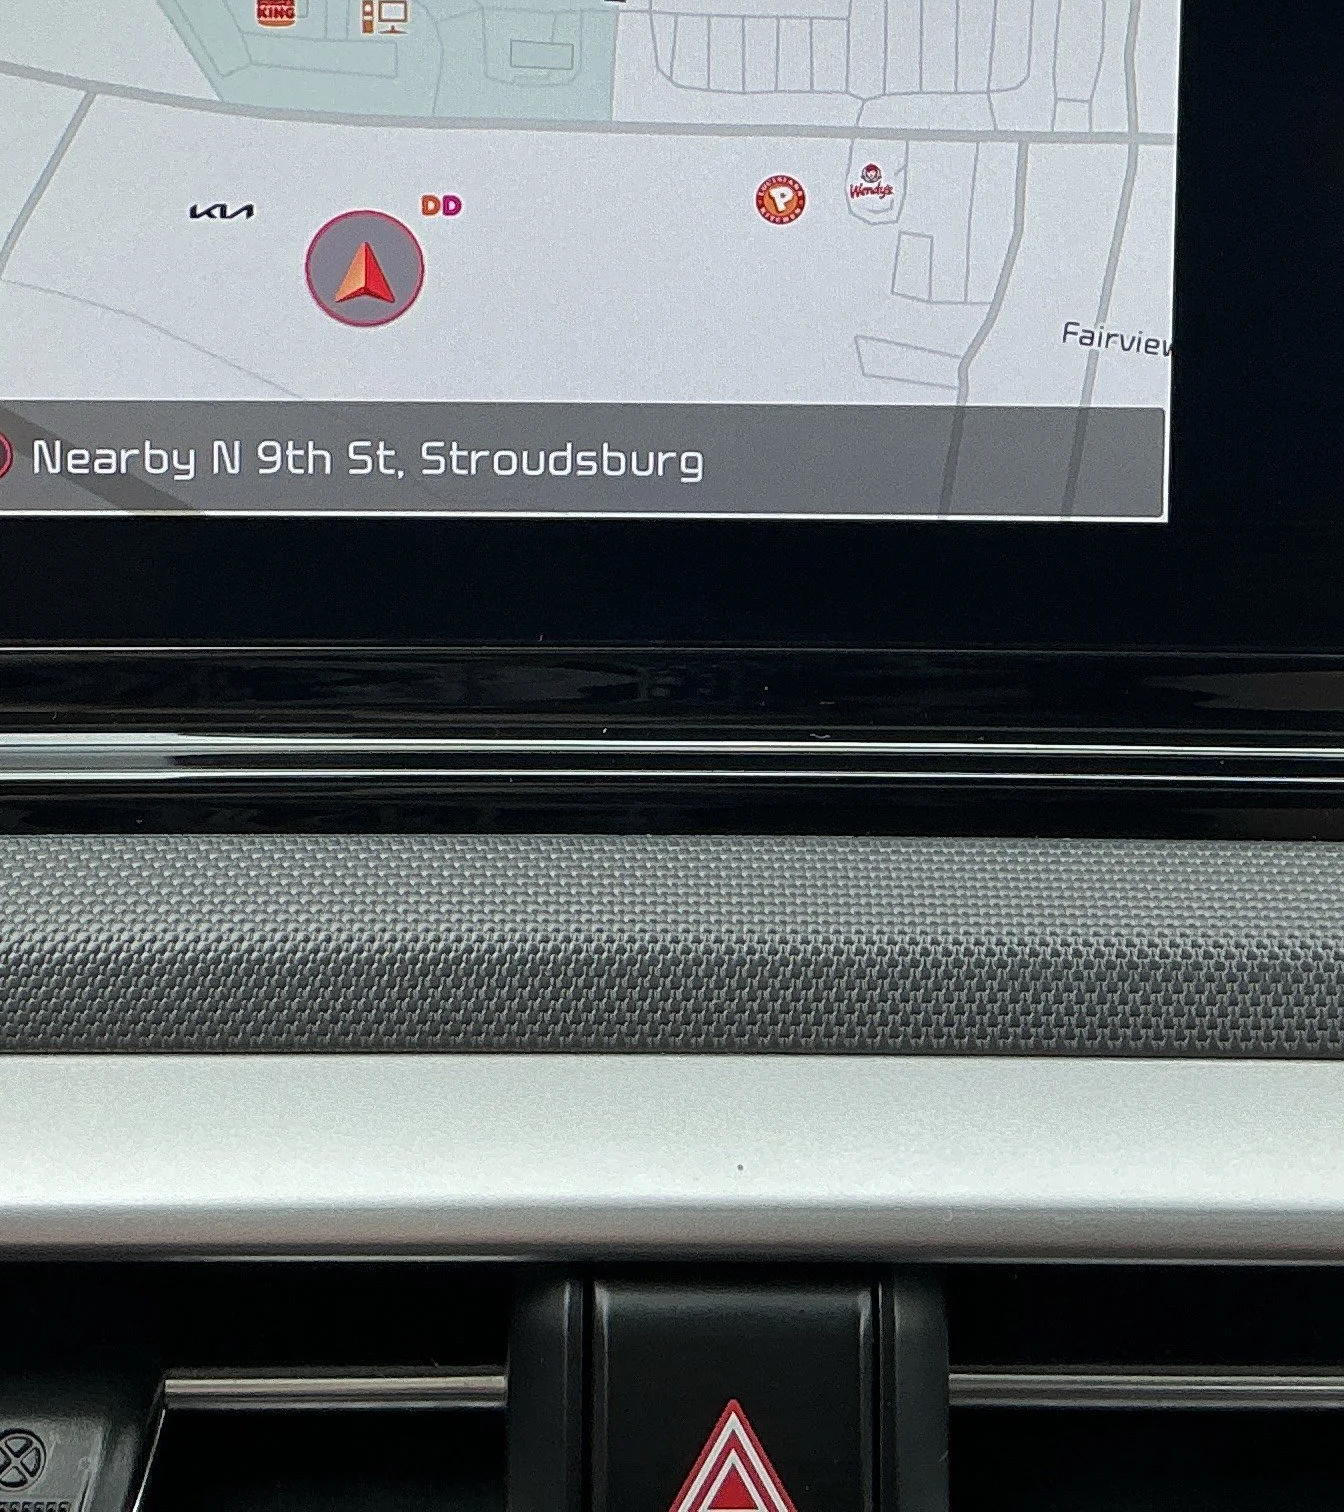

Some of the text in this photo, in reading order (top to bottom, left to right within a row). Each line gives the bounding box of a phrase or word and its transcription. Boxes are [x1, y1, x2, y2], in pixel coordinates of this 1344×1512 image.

[421, 194, 462, 216] DD
[32, 439, 706, 483] Nearby N 9th St, Stroudsburg
